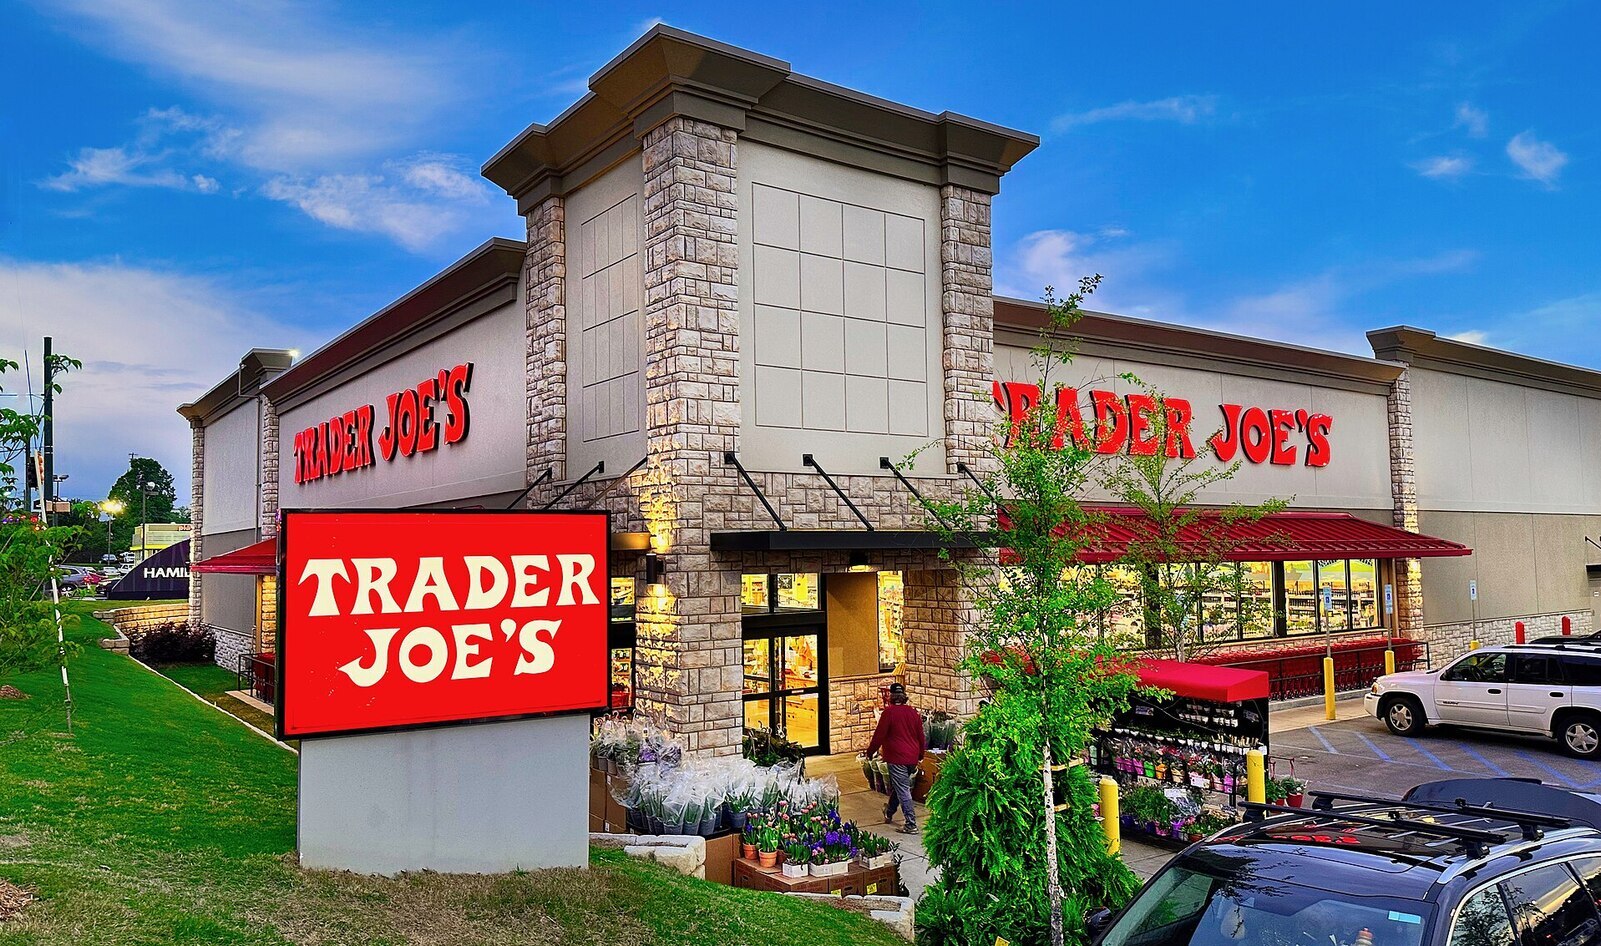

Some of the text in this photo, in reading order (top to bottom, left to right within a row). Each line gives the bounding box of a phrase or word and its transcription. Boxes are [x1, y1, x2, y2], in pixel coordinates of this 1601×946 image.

[293, 362, 474, 484] TRADER JOE'S
[992, 380, 1333, 467] RADER JOE'S
[298, 554, 600, 617] TRADER
[338, 618, 562, 687] JOE'S
